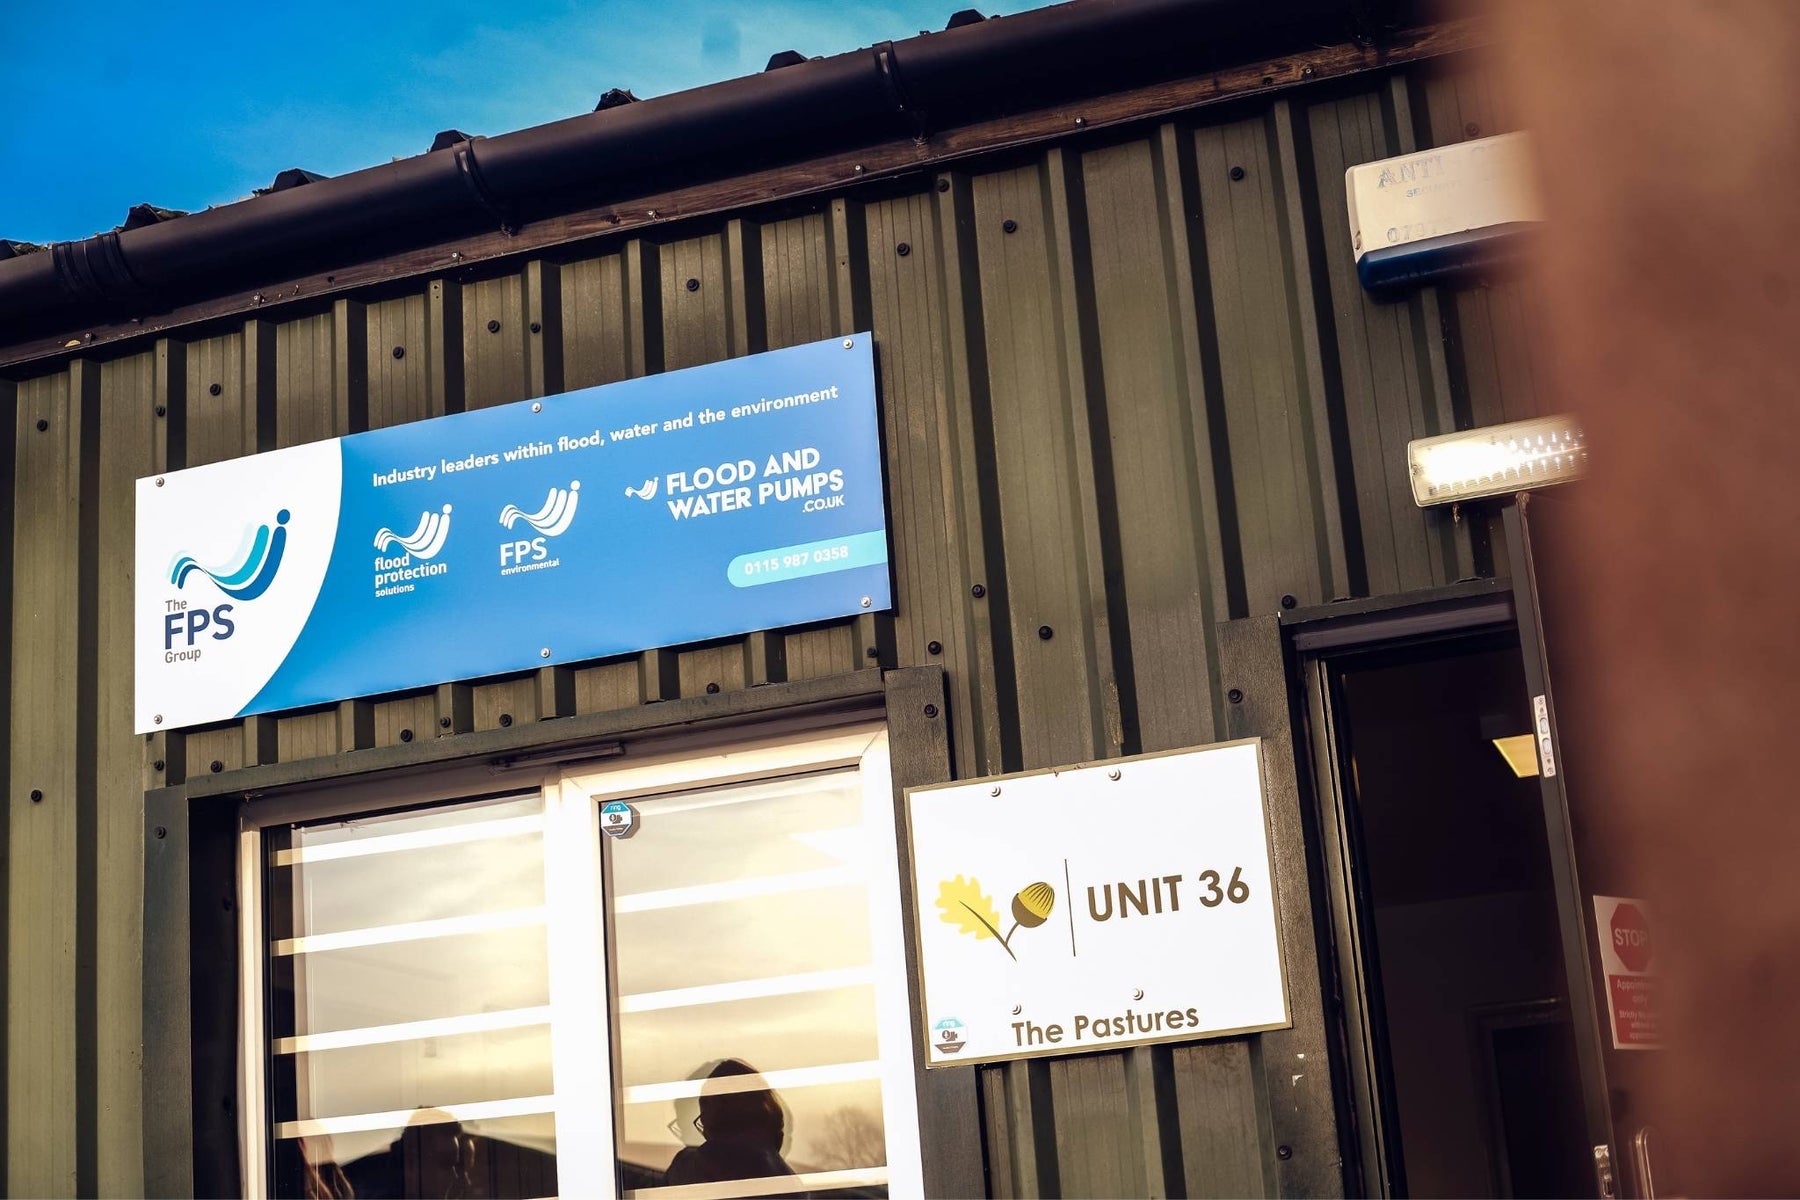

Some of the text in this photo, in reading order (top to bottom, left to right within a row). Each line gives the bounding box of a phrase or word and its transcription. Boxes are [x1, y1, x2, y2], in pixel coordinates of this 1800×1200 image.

[372, 385, 839, 487] Industry leaders within flood, water and the environment
[666, 447, 821, 496] FLOOD AND
[667, 469, 845, 521] WATER PUMPS
[802, 494, 845, 514] .CO.UK
[374, 553, 410, 571] flood
[500, 537, 549, 567] FPS
[744, 545, 849, 576] 0115 987 0358
[375, 561, 448, 589] protection
[500, 558, 560, 576] environmental
[375, 583, 415, 598] solutions
[165, 599, 188, 613] The
[164, 604, 235, 650] FPS
[164, 648, 202, 664] Group
[1087, 866, 1250, 922] UNIT 36
[1614, 928, 1648, 946] STOP
[1011, 1006, 1200, 1047] The Pastures
